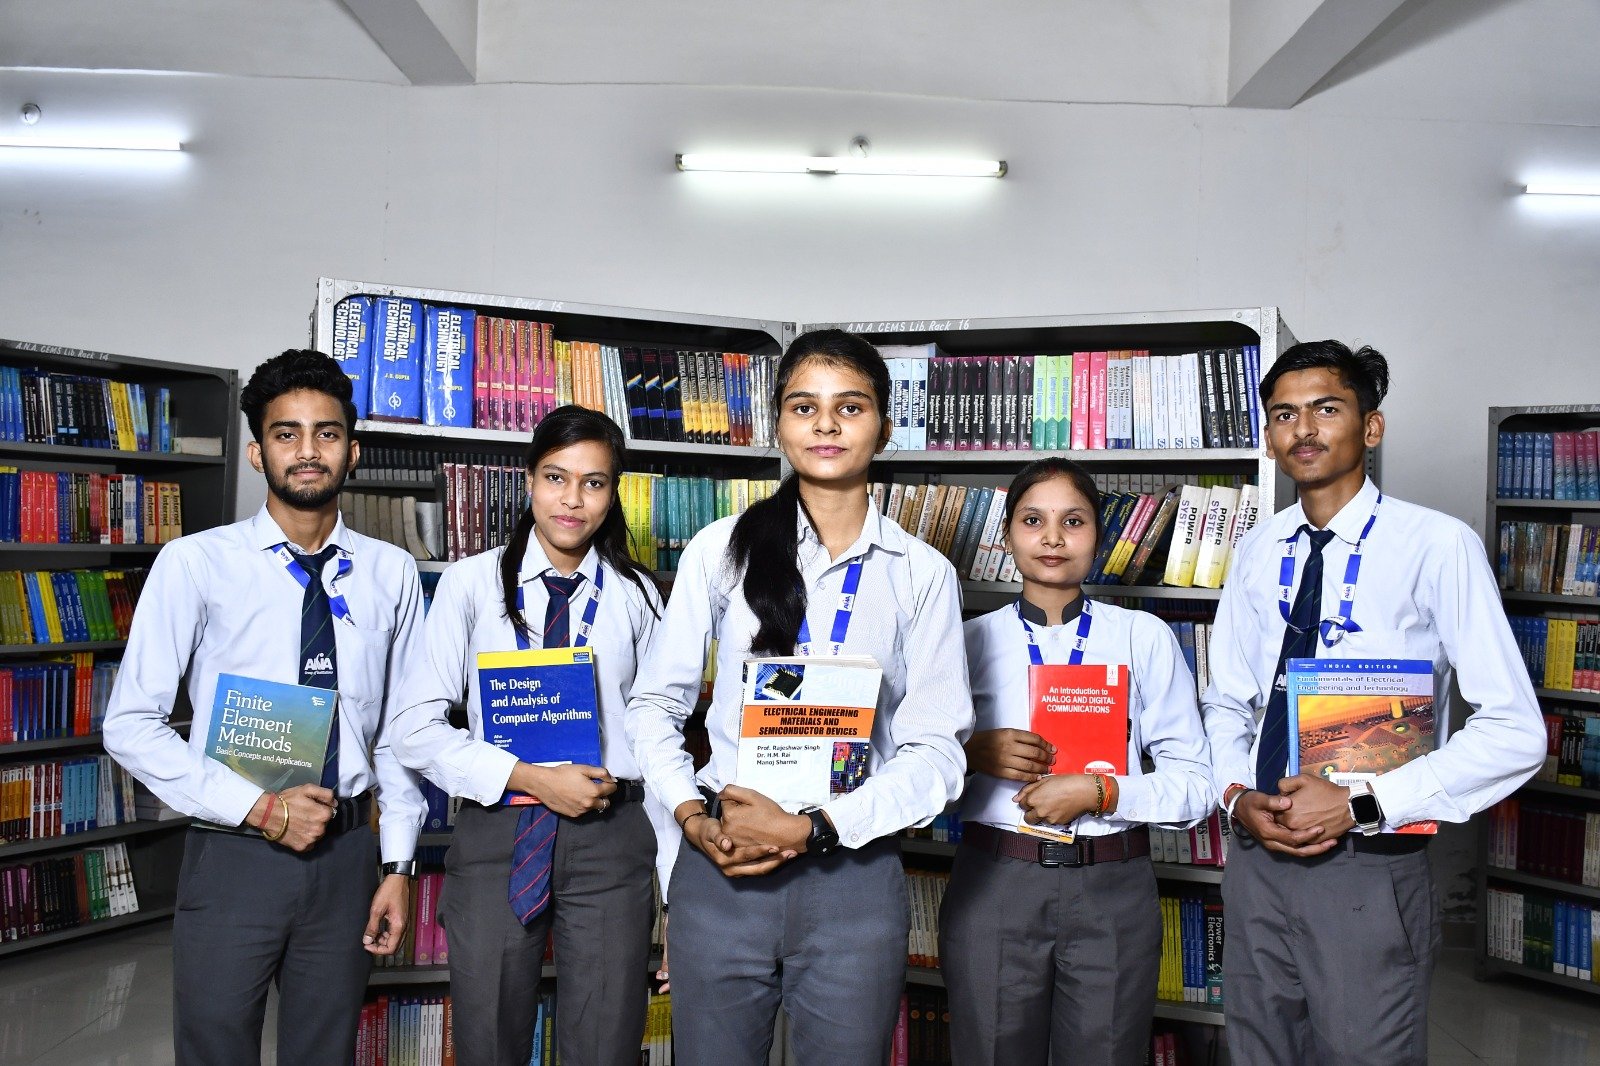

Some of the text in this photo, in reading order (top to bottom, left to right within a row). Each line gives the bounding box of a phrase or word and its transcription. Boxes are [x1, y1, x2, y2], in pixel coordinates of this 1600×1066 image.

[514, 298, 543, 310] Rack
[346, 303, 361, 359] ELECTRICAL
[383, 300, 400, 362] TECHNOLOGY
[396, 304, 412, 360] ELECTRICAL
[929, 320, 951, 330] Rack
[959, 319, 969, 330] 16
[436, 311, 449, 372] TECHNOLOGY
[449, 315, 461, 370] ELECTRICAL
[78, 349, 93, 359] Rack
[1206, 375, 1214, 394] CONTROL
[962, 502, 972, 523] Control
[975, 501, 985, 522] Control
[1185, 507, 1197, 544] POWER
[1215, 508, 1227, 545] POWER
[490, 678, 541, 691] The Design
[1049, 686, 1059, 694] An
[1060, 686, 1100, 695] Introduction
[224, 690, 272, 712] Finite
[491, 692, 560, 708] and Analysis of
[1041, 695, 1116, 705] ANALOG AND DIGITAL
[1046, 704, 1110, 714] COMMUNICATIONS
[222, 708, 293, 734] Element
[492, 709, 592, 726] Computer Algorithms
[764, 708, 859, 717] ELECTRICAL ENGINEERING
[780, 717, 839, 726] MATERIALS AND
[218, 726, 292, 752] Methods
[759, 727, 858, 735] SEMICONDUCTOR DEVICES
[216, 746, 312, 768] Basic Concepts and Applications
[1207, 917, 1215, 961] Electronics
[1215, 917, 1223, 945] Power
[445, 1029, 453, 1058] Analysis
